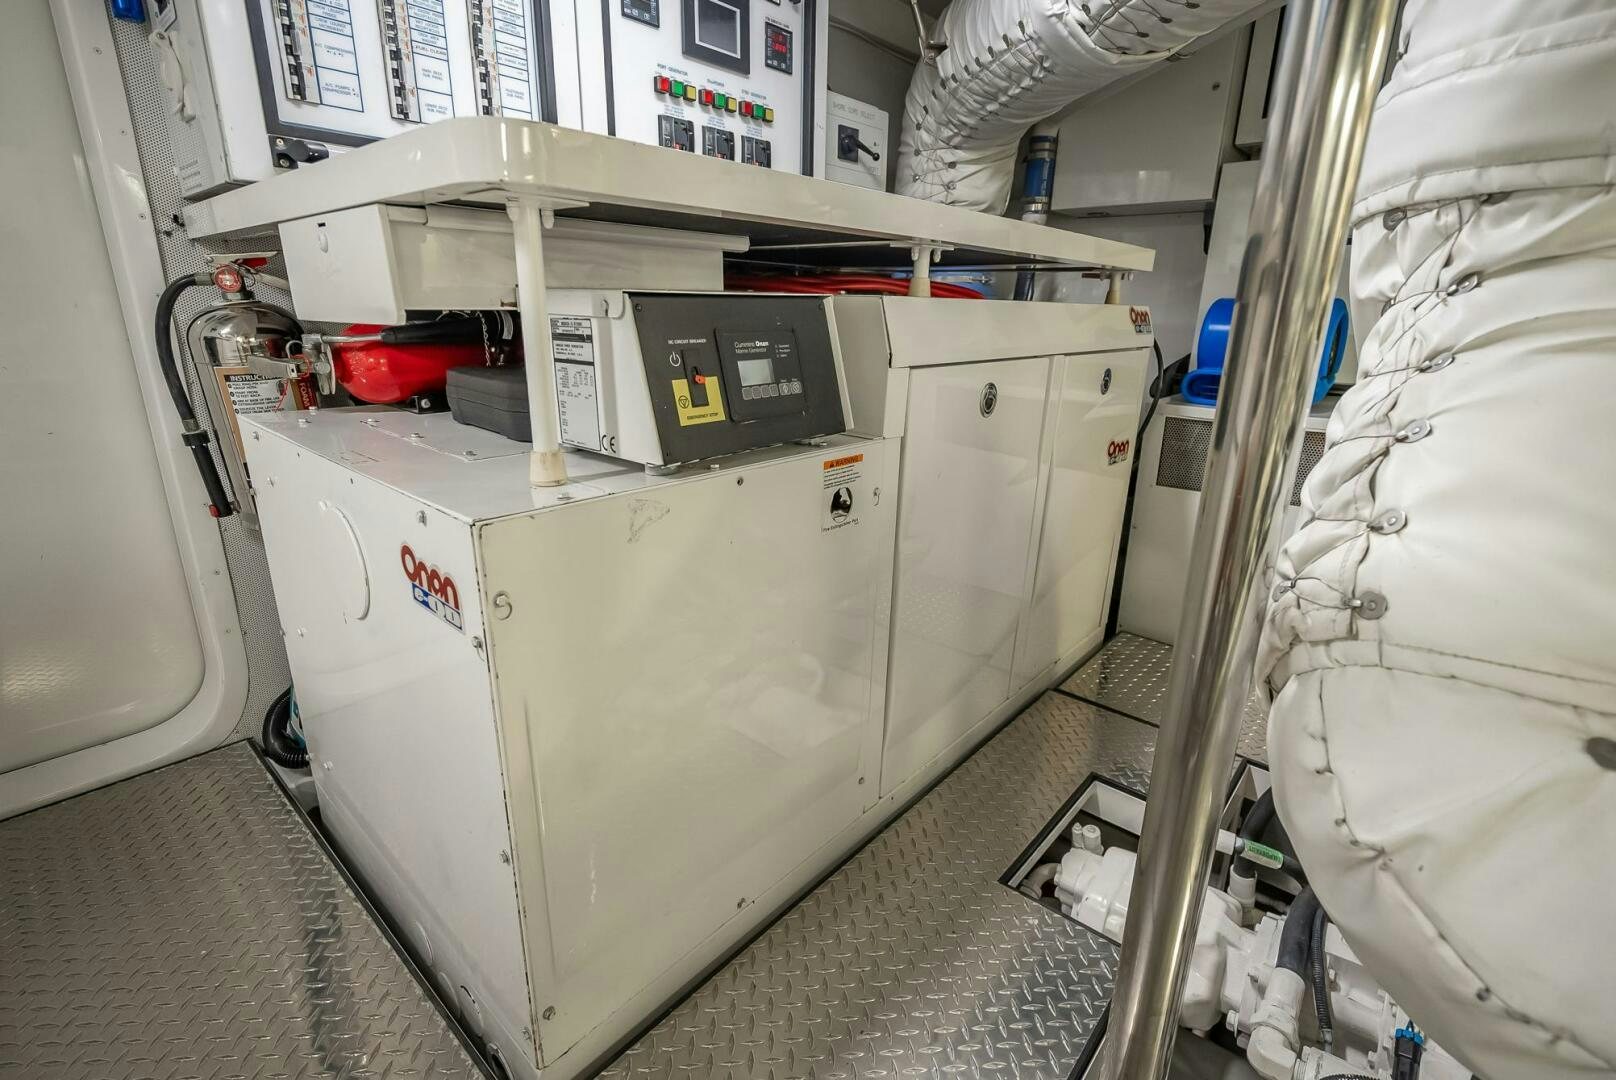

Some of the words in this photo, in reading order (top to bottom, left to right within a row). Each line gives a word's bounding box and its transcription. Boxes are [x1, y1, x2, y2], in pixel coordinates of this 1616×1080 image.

[1130, 306, 1151, 325] Onan
[602, 435, 616, 453] CE
[1108, 440, 1129, 457] Onan
[835, 455, 860, 467] WARNING
[401, 545, 460, 611] Onan
